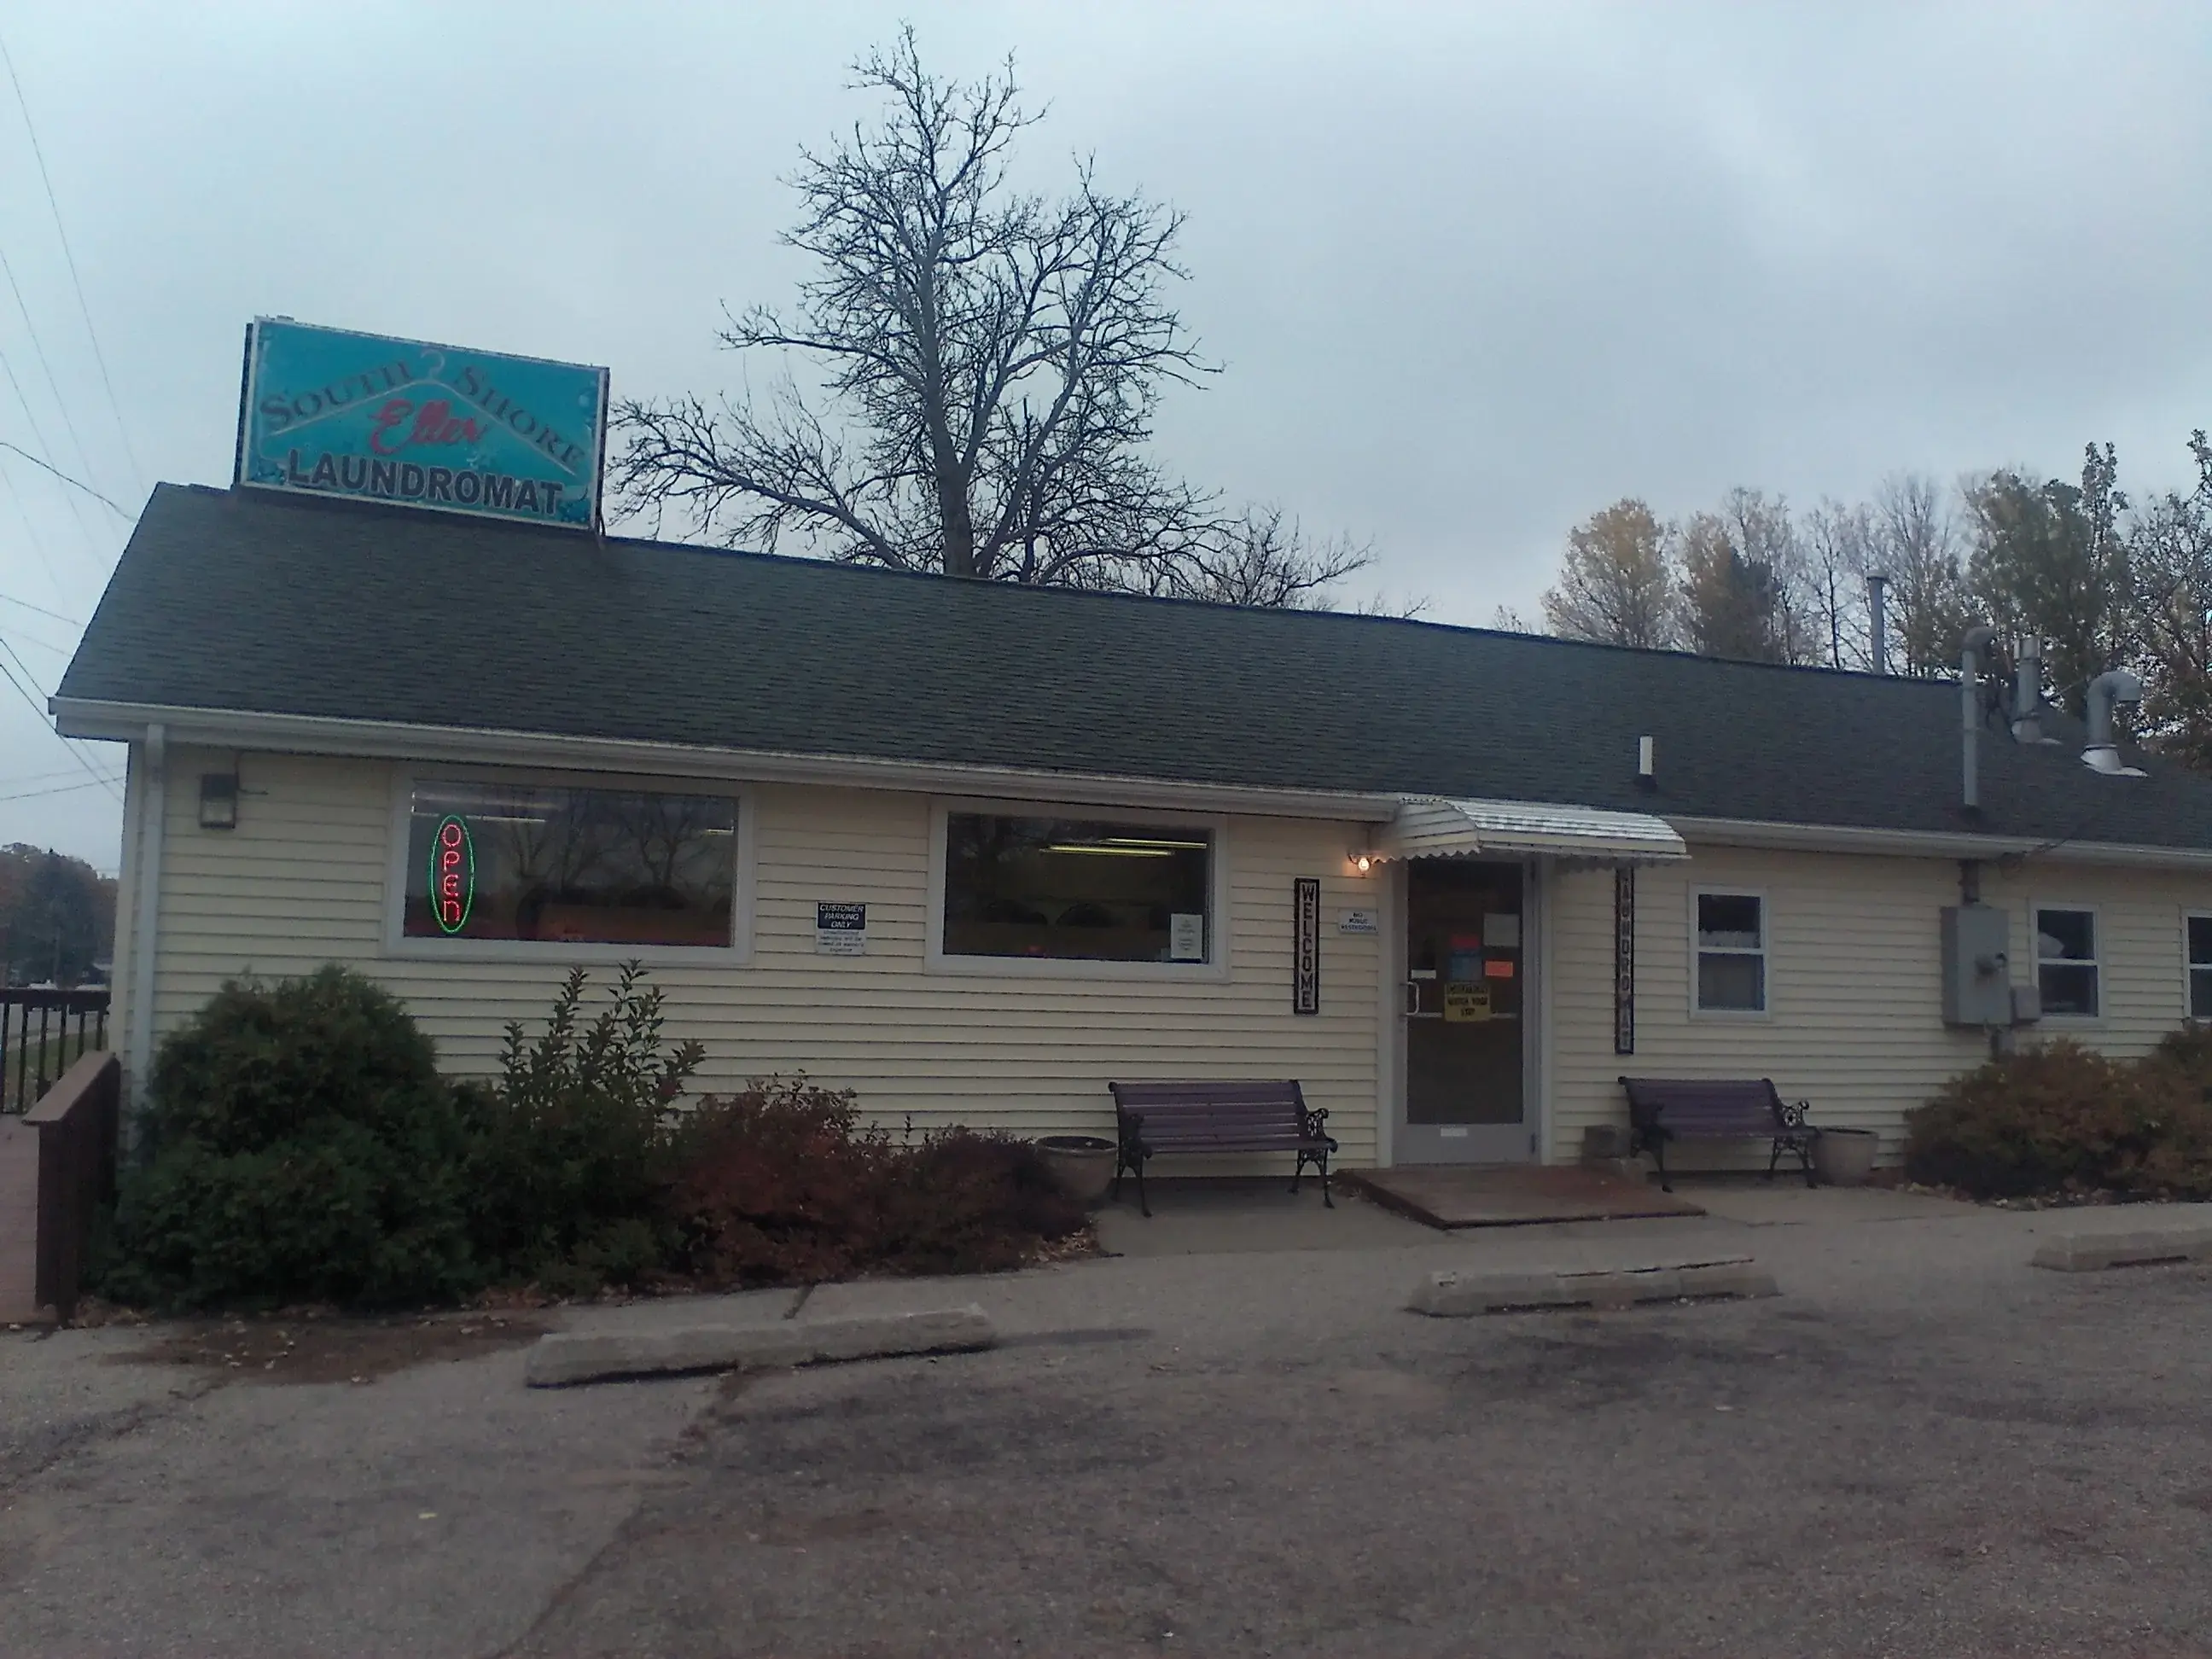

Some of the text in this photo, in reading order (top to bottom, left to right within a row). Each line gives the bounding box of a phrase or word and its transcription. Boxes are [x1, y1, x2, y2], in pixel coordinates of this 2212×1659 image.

[259, 358, 585, 467] SOUTH SHORE
[288, 448, 564, 515] LAUNDROMAT
[442, 824, 462, 922] OPEN
[824, 912, 859, 921] PARKING
[1301, 883, 1315, 1009] WELCOME
